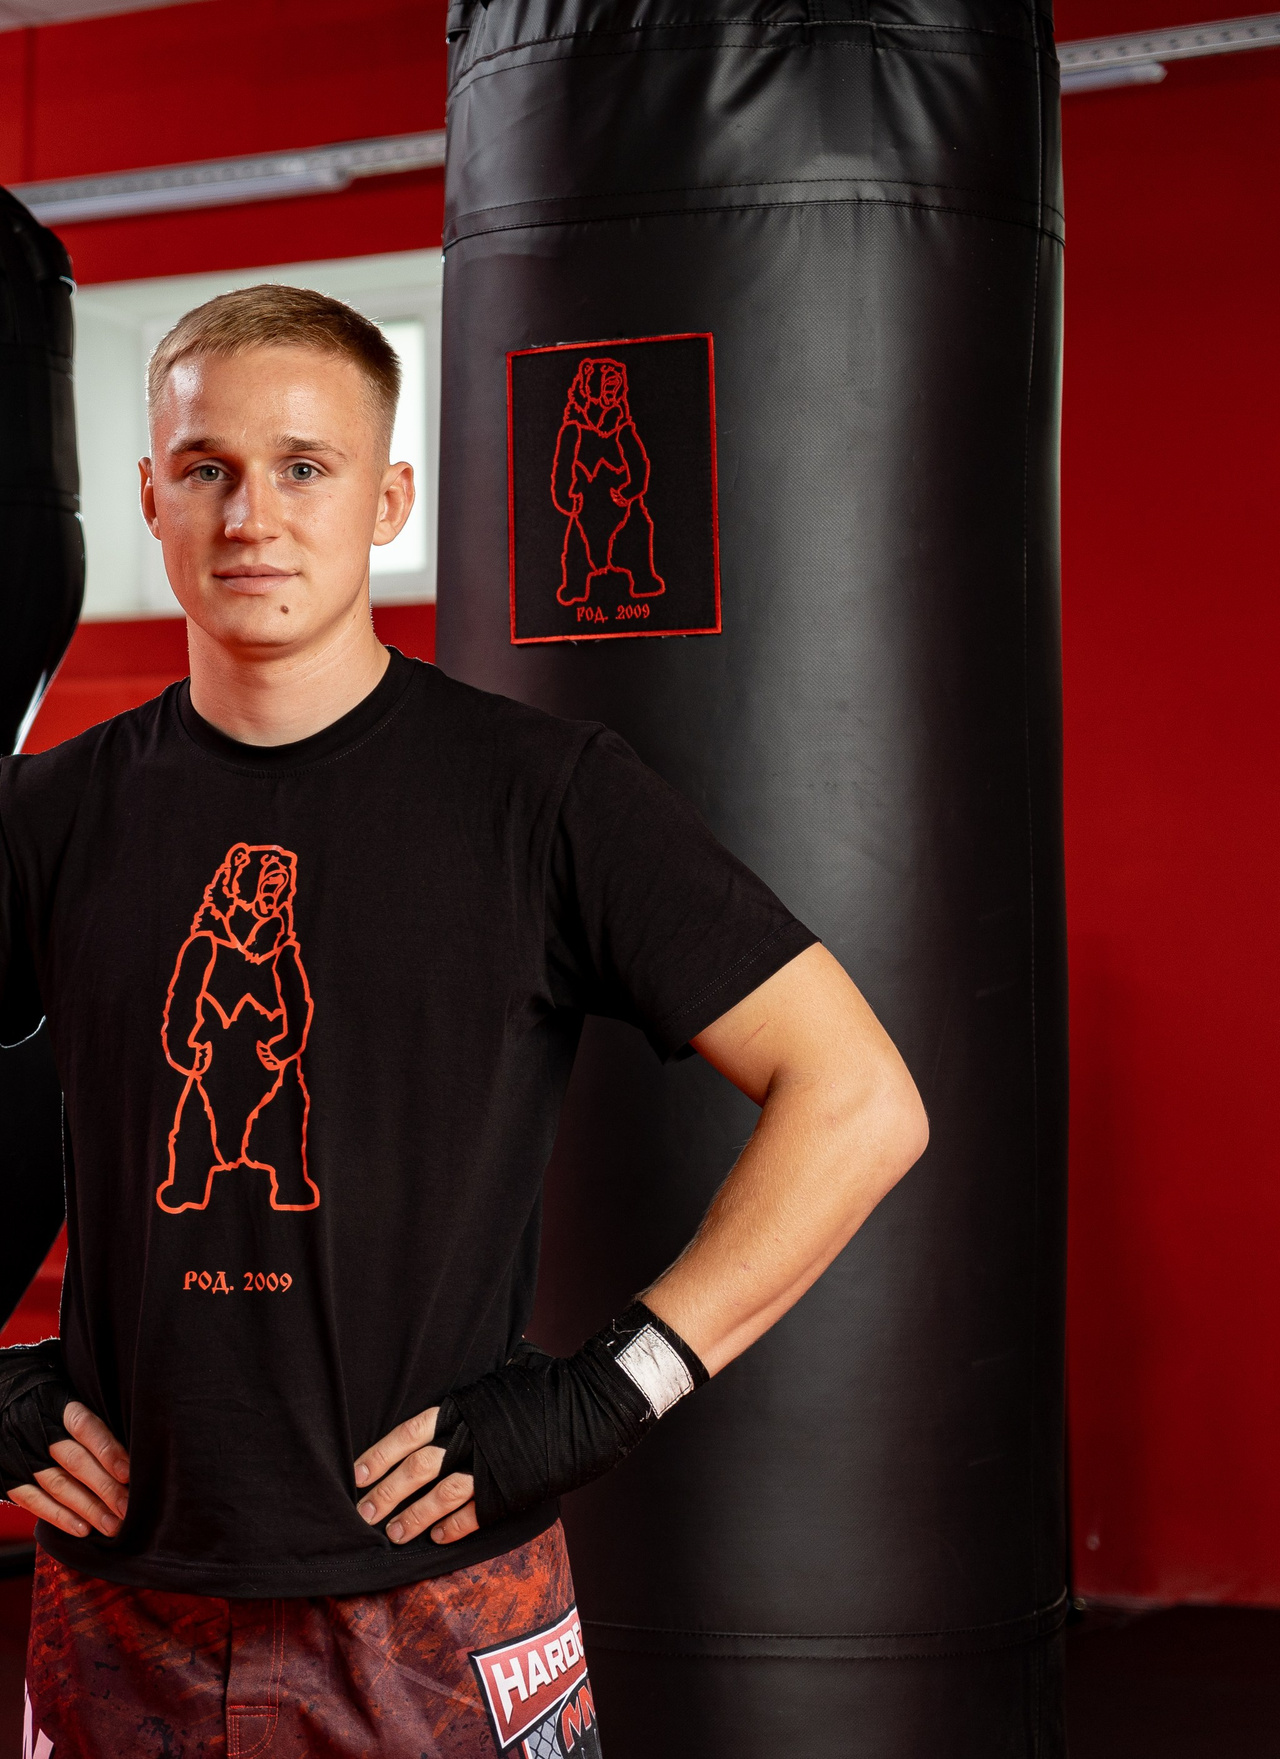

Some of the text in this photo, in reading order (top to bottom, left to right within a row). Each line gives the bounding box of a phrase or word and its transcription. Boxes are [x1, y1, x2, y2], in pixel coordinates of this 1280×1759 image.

[615, 603, 651, 620] 2009
[183, 1270, 293, 1295] РОД. 2009
